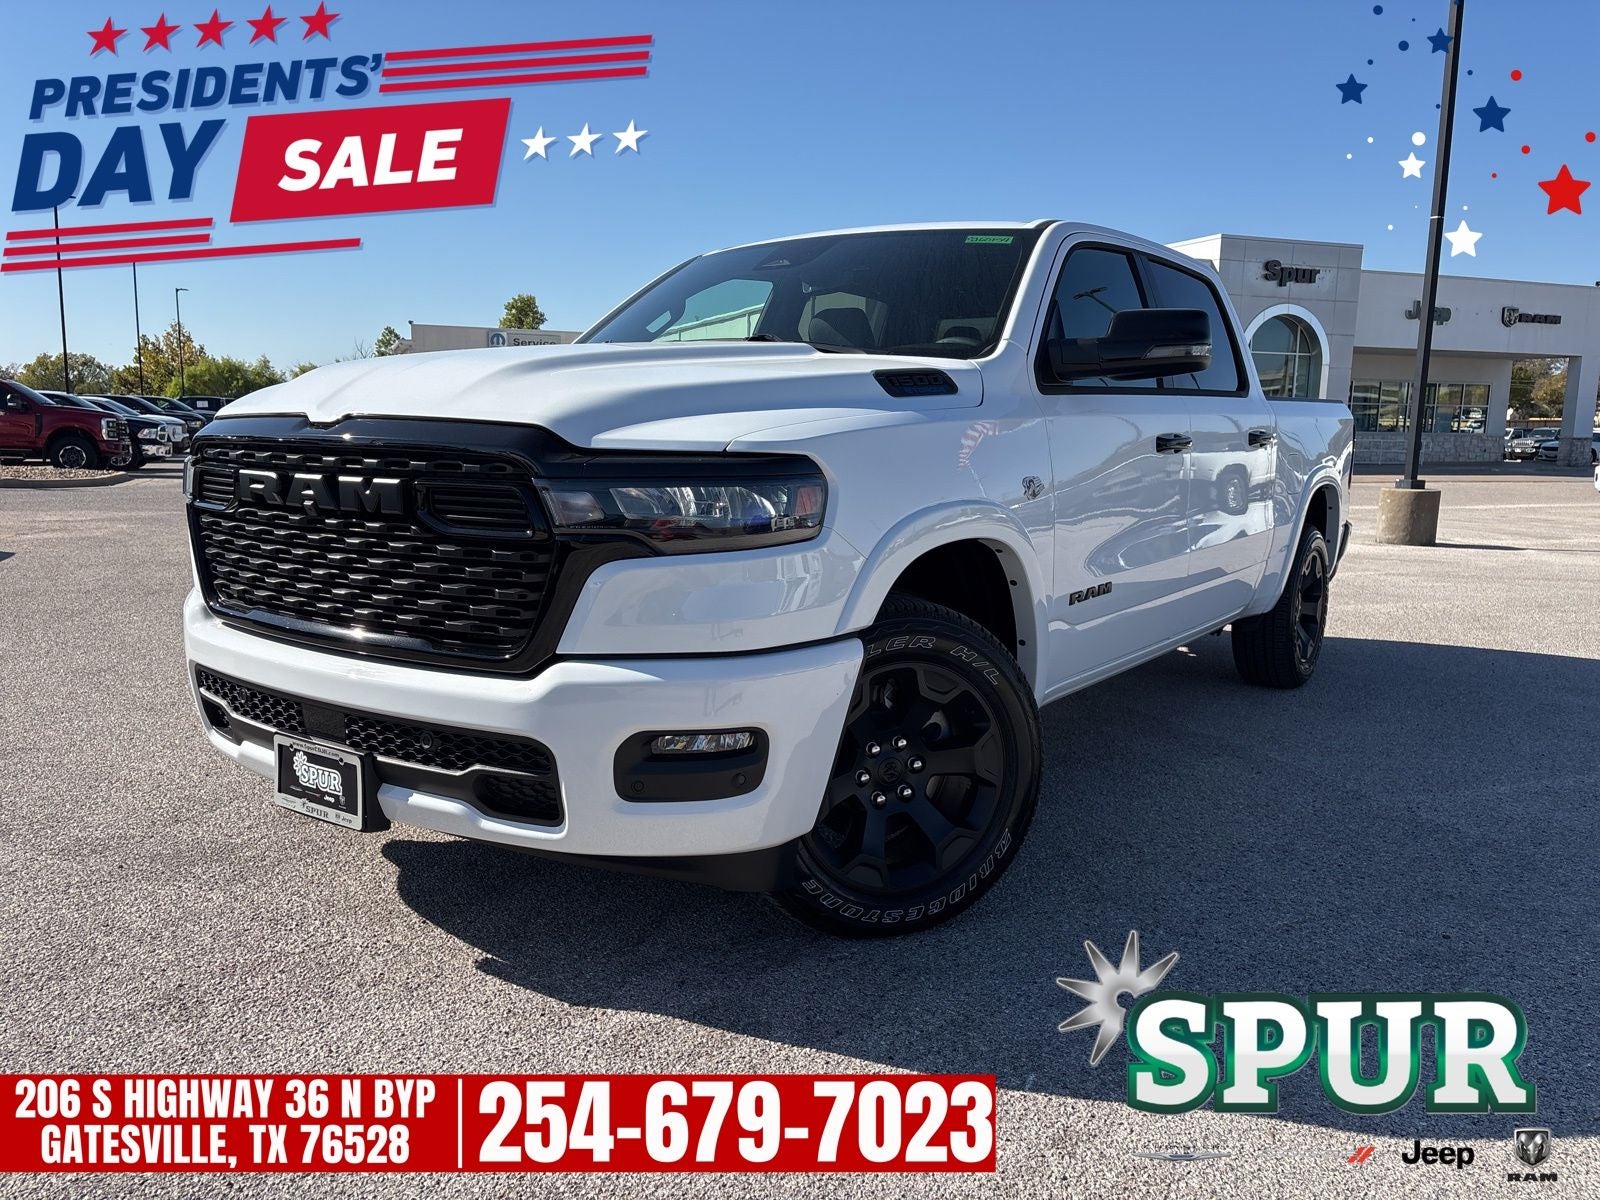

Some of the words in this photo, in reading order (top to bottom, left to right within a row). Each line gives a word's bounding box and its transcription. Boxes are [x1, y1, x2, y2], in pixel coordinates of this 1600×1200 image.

[1264, 259, 1320, 287] Spur
[1405, 300, 1451, 325] Jp
[1519, 313, 1562, 324] RAM
[239, 469, 403, 515] RAM
[1069, 581, 1112, 606] RAM
[866, 635, 936, 659] LER
[300, 763, 342, 795] SPUR
[305, 805, 329, 818] SPUR
[802, 828, 1013, 923] BRIDGESTONE
